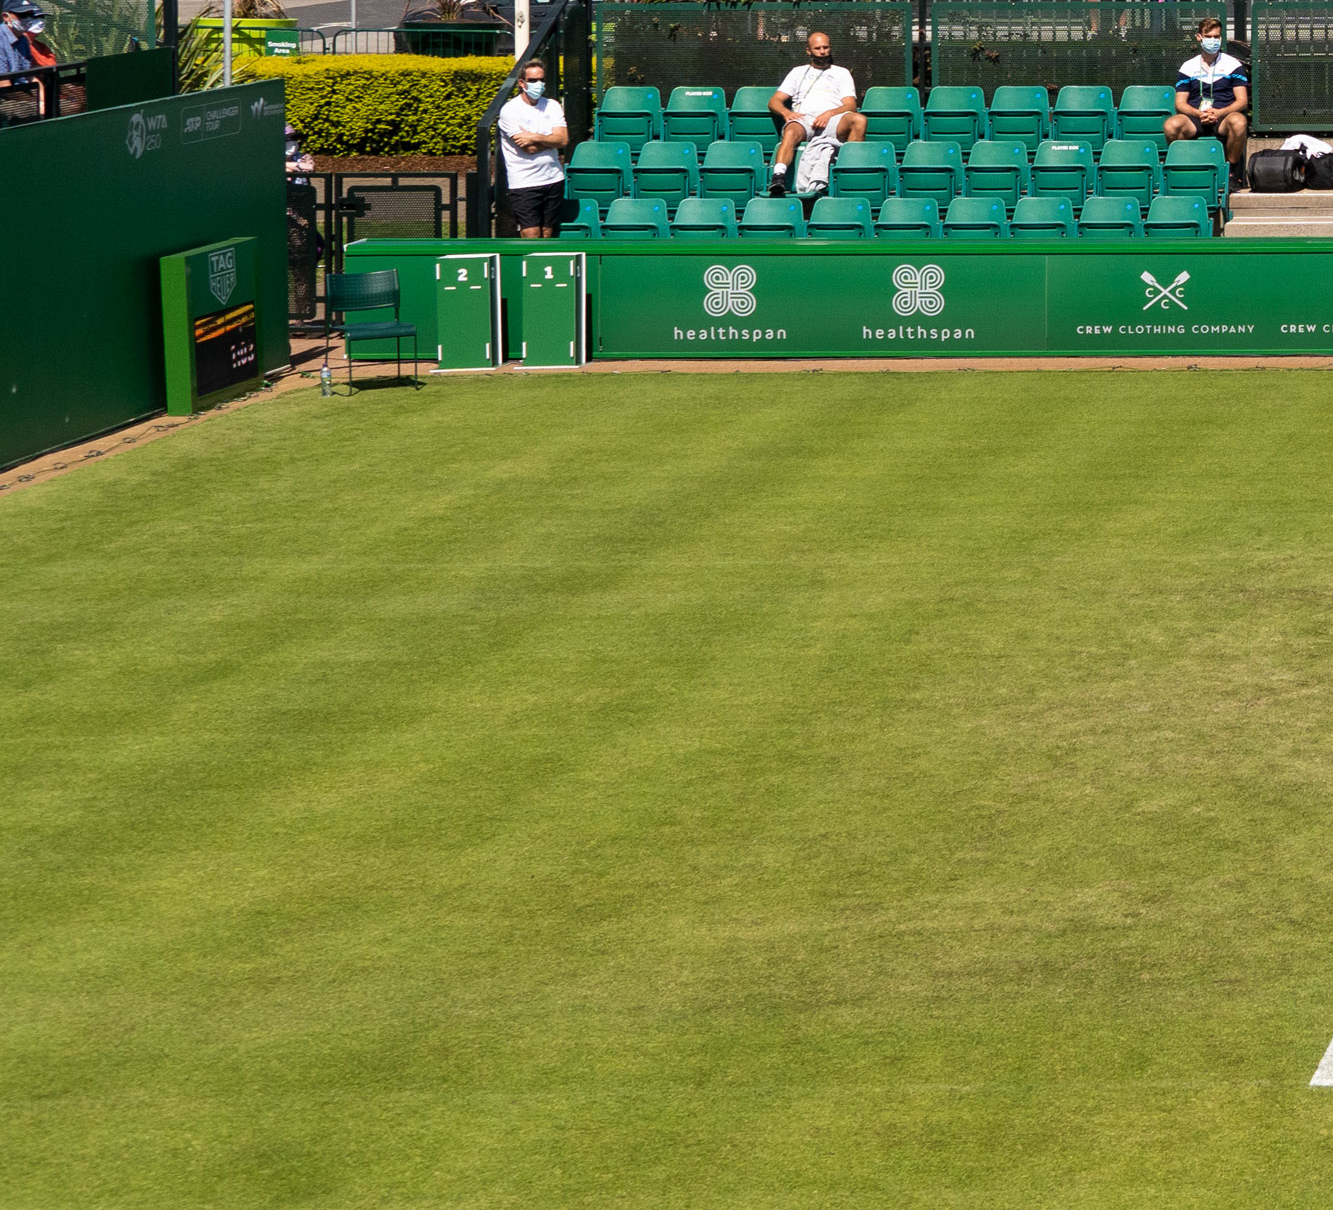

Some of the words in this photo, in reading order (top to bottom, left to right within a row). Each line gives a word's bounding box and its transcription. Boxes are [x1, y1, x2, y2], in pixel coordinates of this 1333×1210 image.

[268, 41, 296, 49] Smoking
[205, 106, 239, 121] CHALLENGER
[147, 114, 168, 131] WTA
[211, 252, 233, 273] TAG
[457, 268, 468, 281] 2
[544, 266, 553, 279] 1
[211, 274, 236, 300] HEUER
[673, 326, 787, 341] healthspan
[862, 326, 975, 341] healthspan
[1076, 325, 1113, 334] CREW
[1119, 325, 1185, 334] CLOTHING
[1192, 324, 1255, 334] COMPANY
[1280, 324, 1316, 333] CREW
